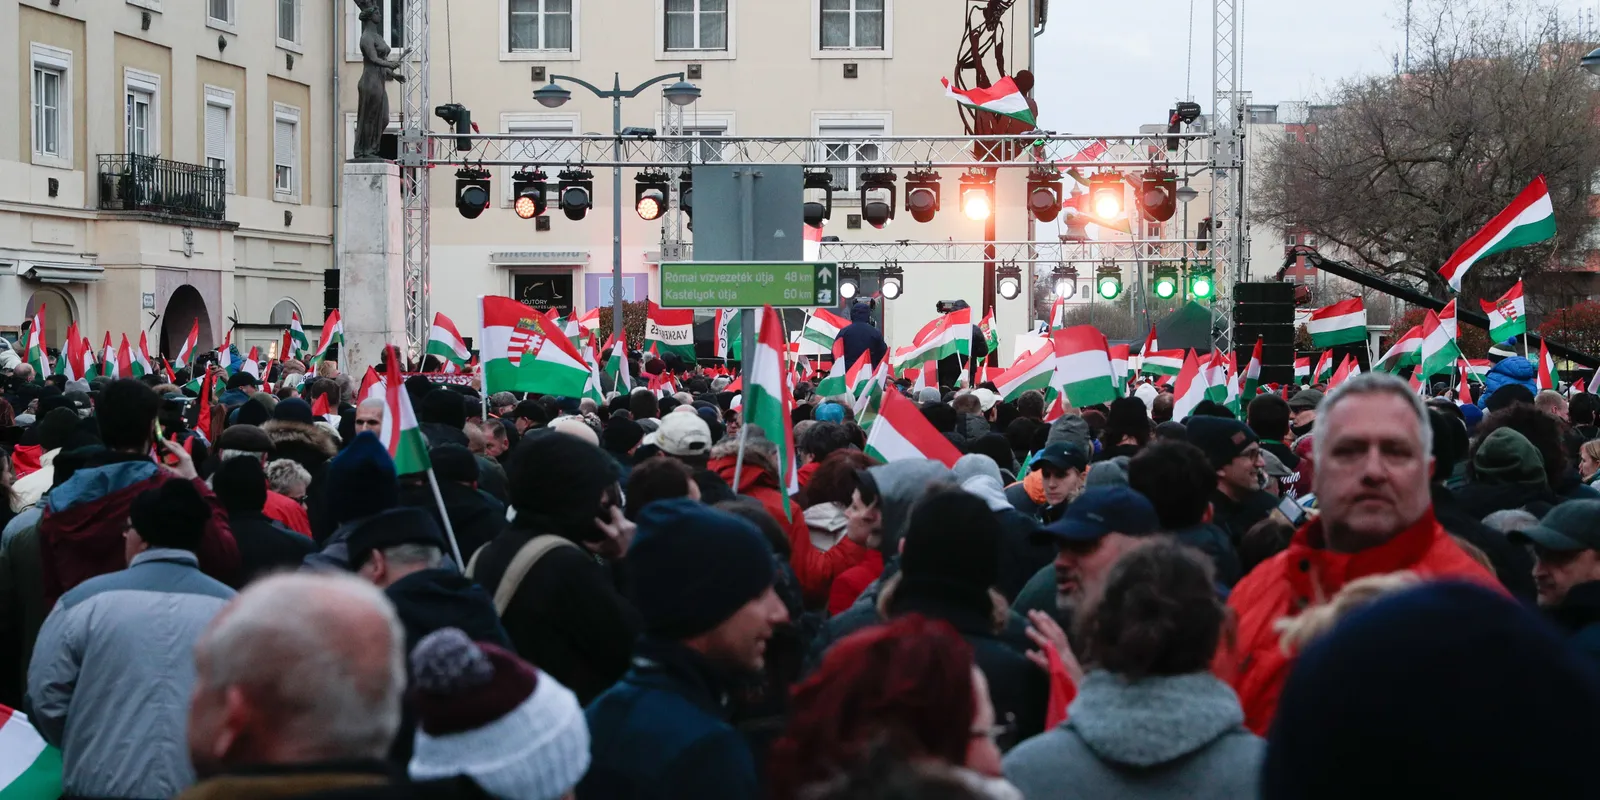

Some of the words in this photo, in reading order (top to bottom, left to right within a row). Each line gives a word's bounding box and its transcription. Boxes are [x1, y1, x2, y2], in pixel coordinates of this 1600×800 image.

[665, 272, 697, 283] Római
[700, 272, 752, 283] vízvezeték
[756, 272, 774, 285] útja
[784, 272, 797, 282] 48
[800, 274, 812, 282] km
[665, 289, 714, 302] Kastélyok
[718, 289, 737, 302] útja
[784, 289, 797, 299] 60
[800, 291, 812, 299] km
